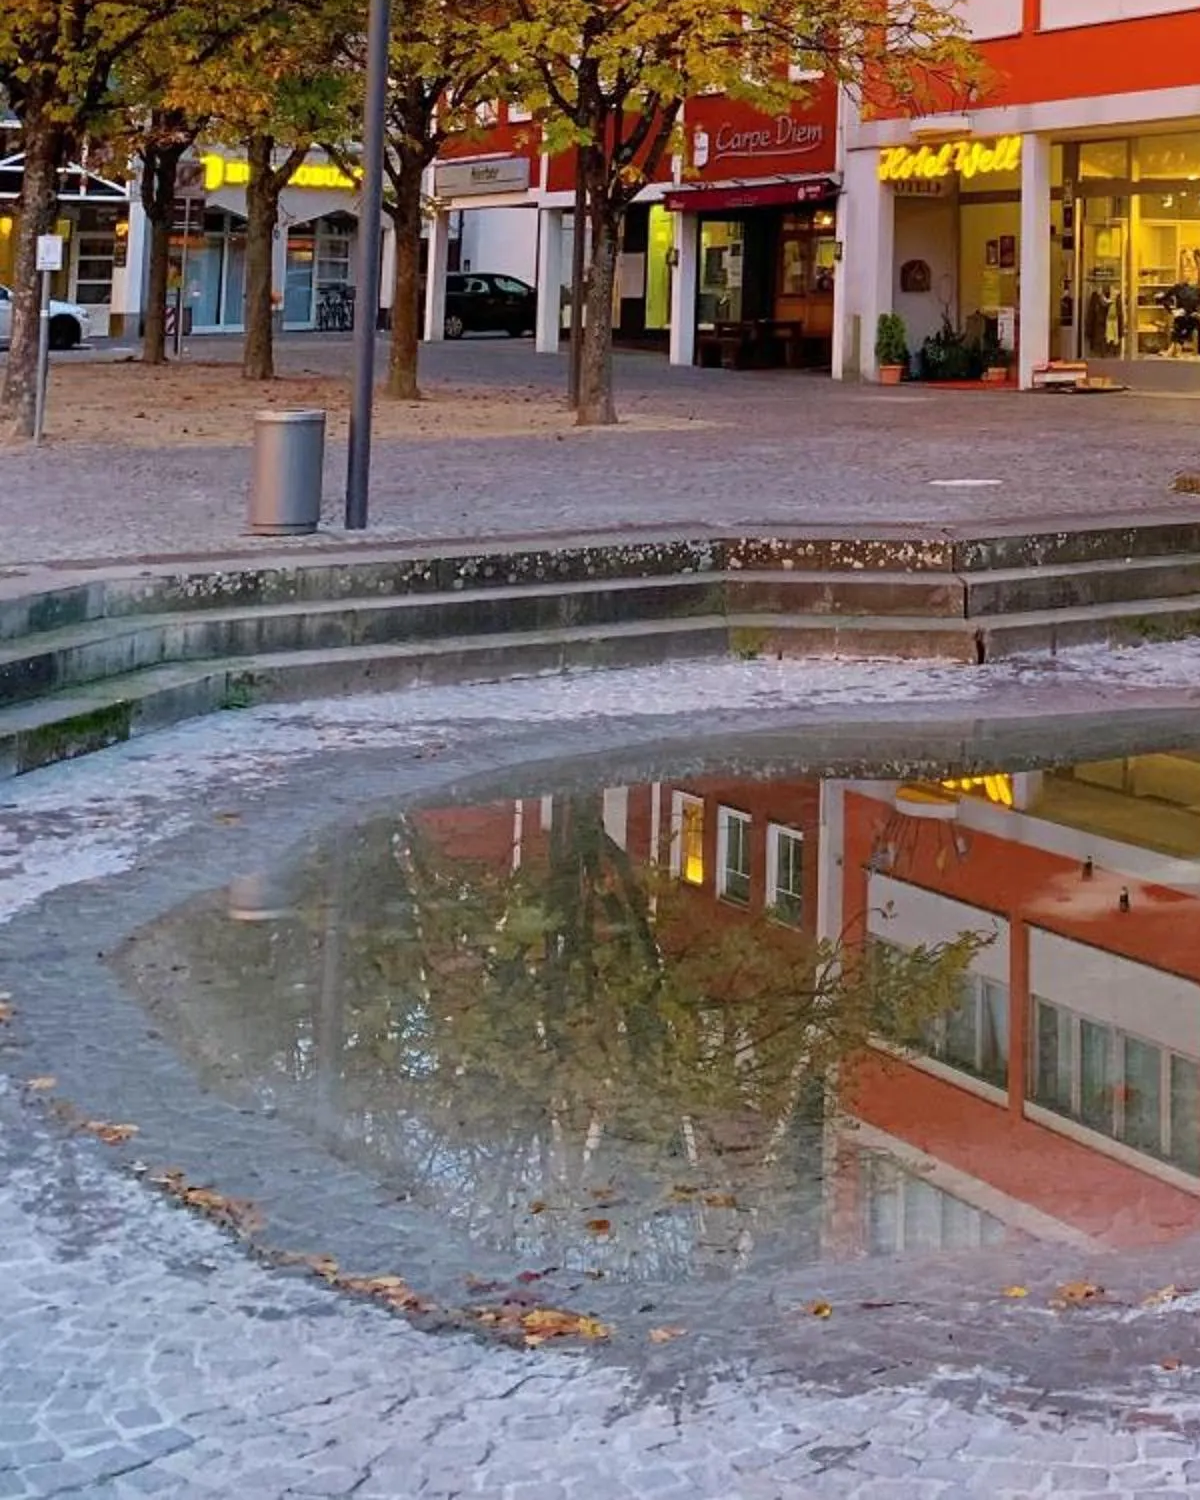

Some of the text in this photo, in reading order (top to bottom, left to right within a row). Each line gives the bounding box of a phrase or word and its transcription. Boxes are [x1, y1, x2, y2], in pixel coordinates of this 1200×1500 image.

[715, 122, 770, 154] Carpe
[775, 115, 822, 145] Diem
[879, 135, 1021, 180] Hotel Well
